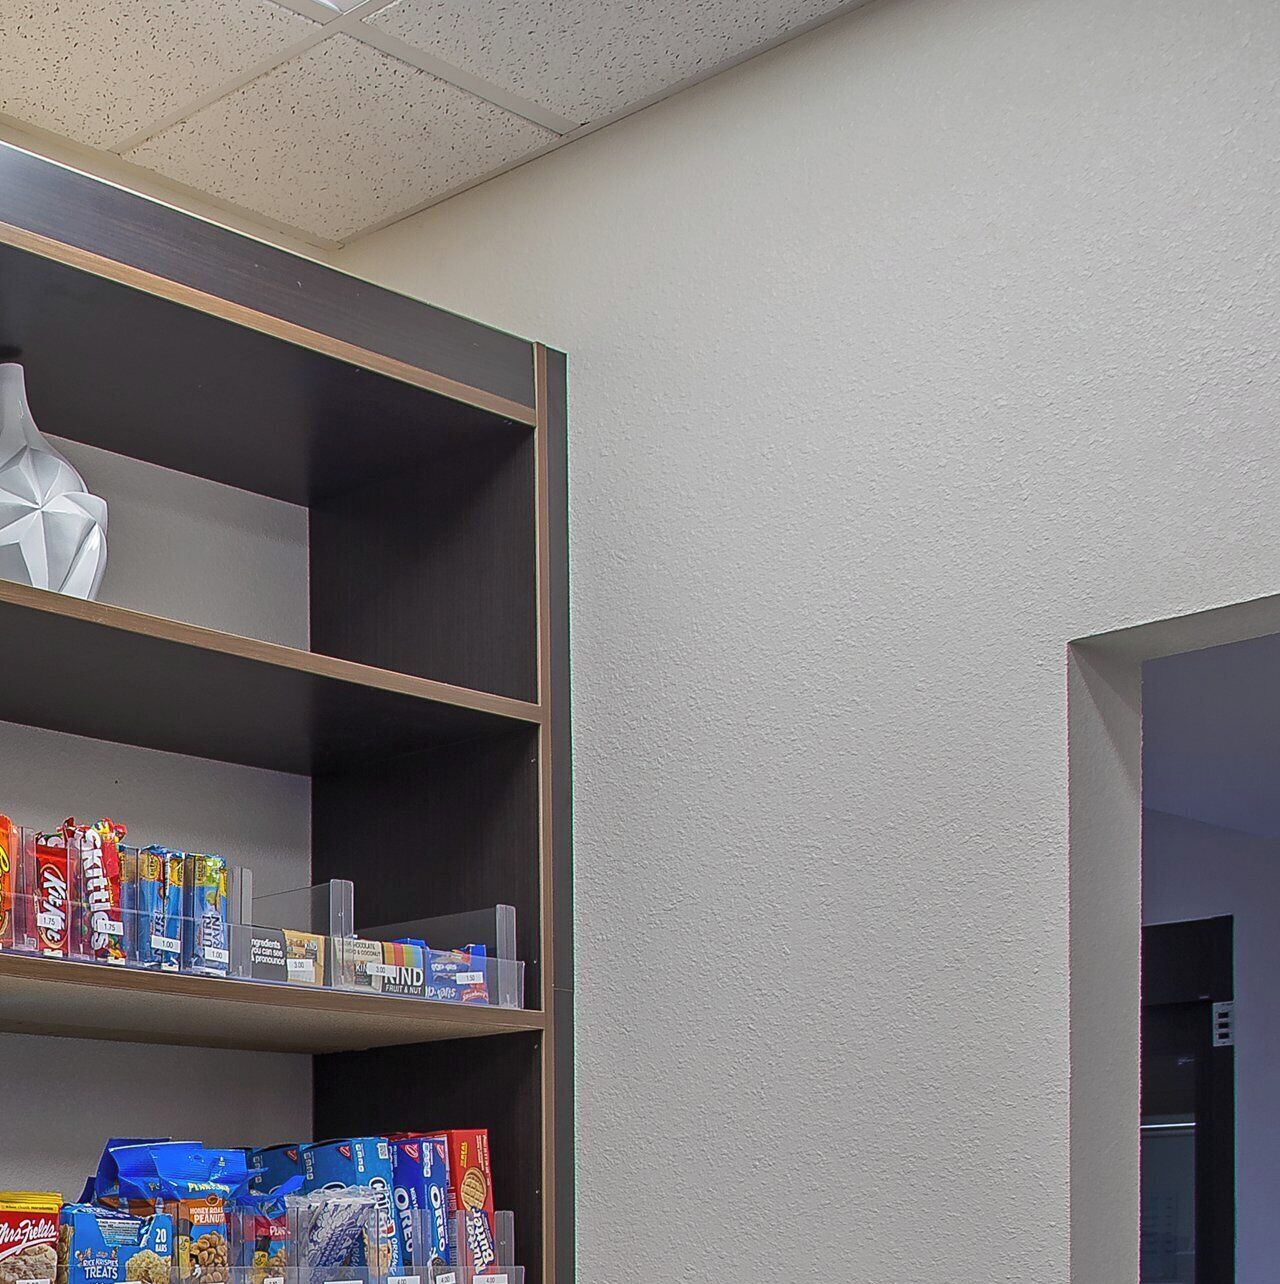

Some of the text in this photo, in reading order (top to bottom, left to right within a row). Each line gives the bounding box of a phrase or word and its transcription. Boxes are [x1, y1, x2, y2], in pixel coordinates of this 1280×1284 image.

[43, 917, 56, 926] 1.75
[104, 923, 116, 931] 1.75
[162, 940, 174, 949] 1.00
[212, 951, 223, 959] 1.00
[293, 961, 305, 969] 3.00
[375, 966, 386, 974] 3.00
[465, 974, 476, 982] 1.50
[385, 985, 422, 994] FRUIT NUT
[430, 1184, 446, 1252] OREO
[155, 1228, 167, 1244] 20
[155, 1243, 168, 1252] BARS
[95, 1258, 119, 1268] KRISPIES
[84, 1266, 119, 1280] TREATS
